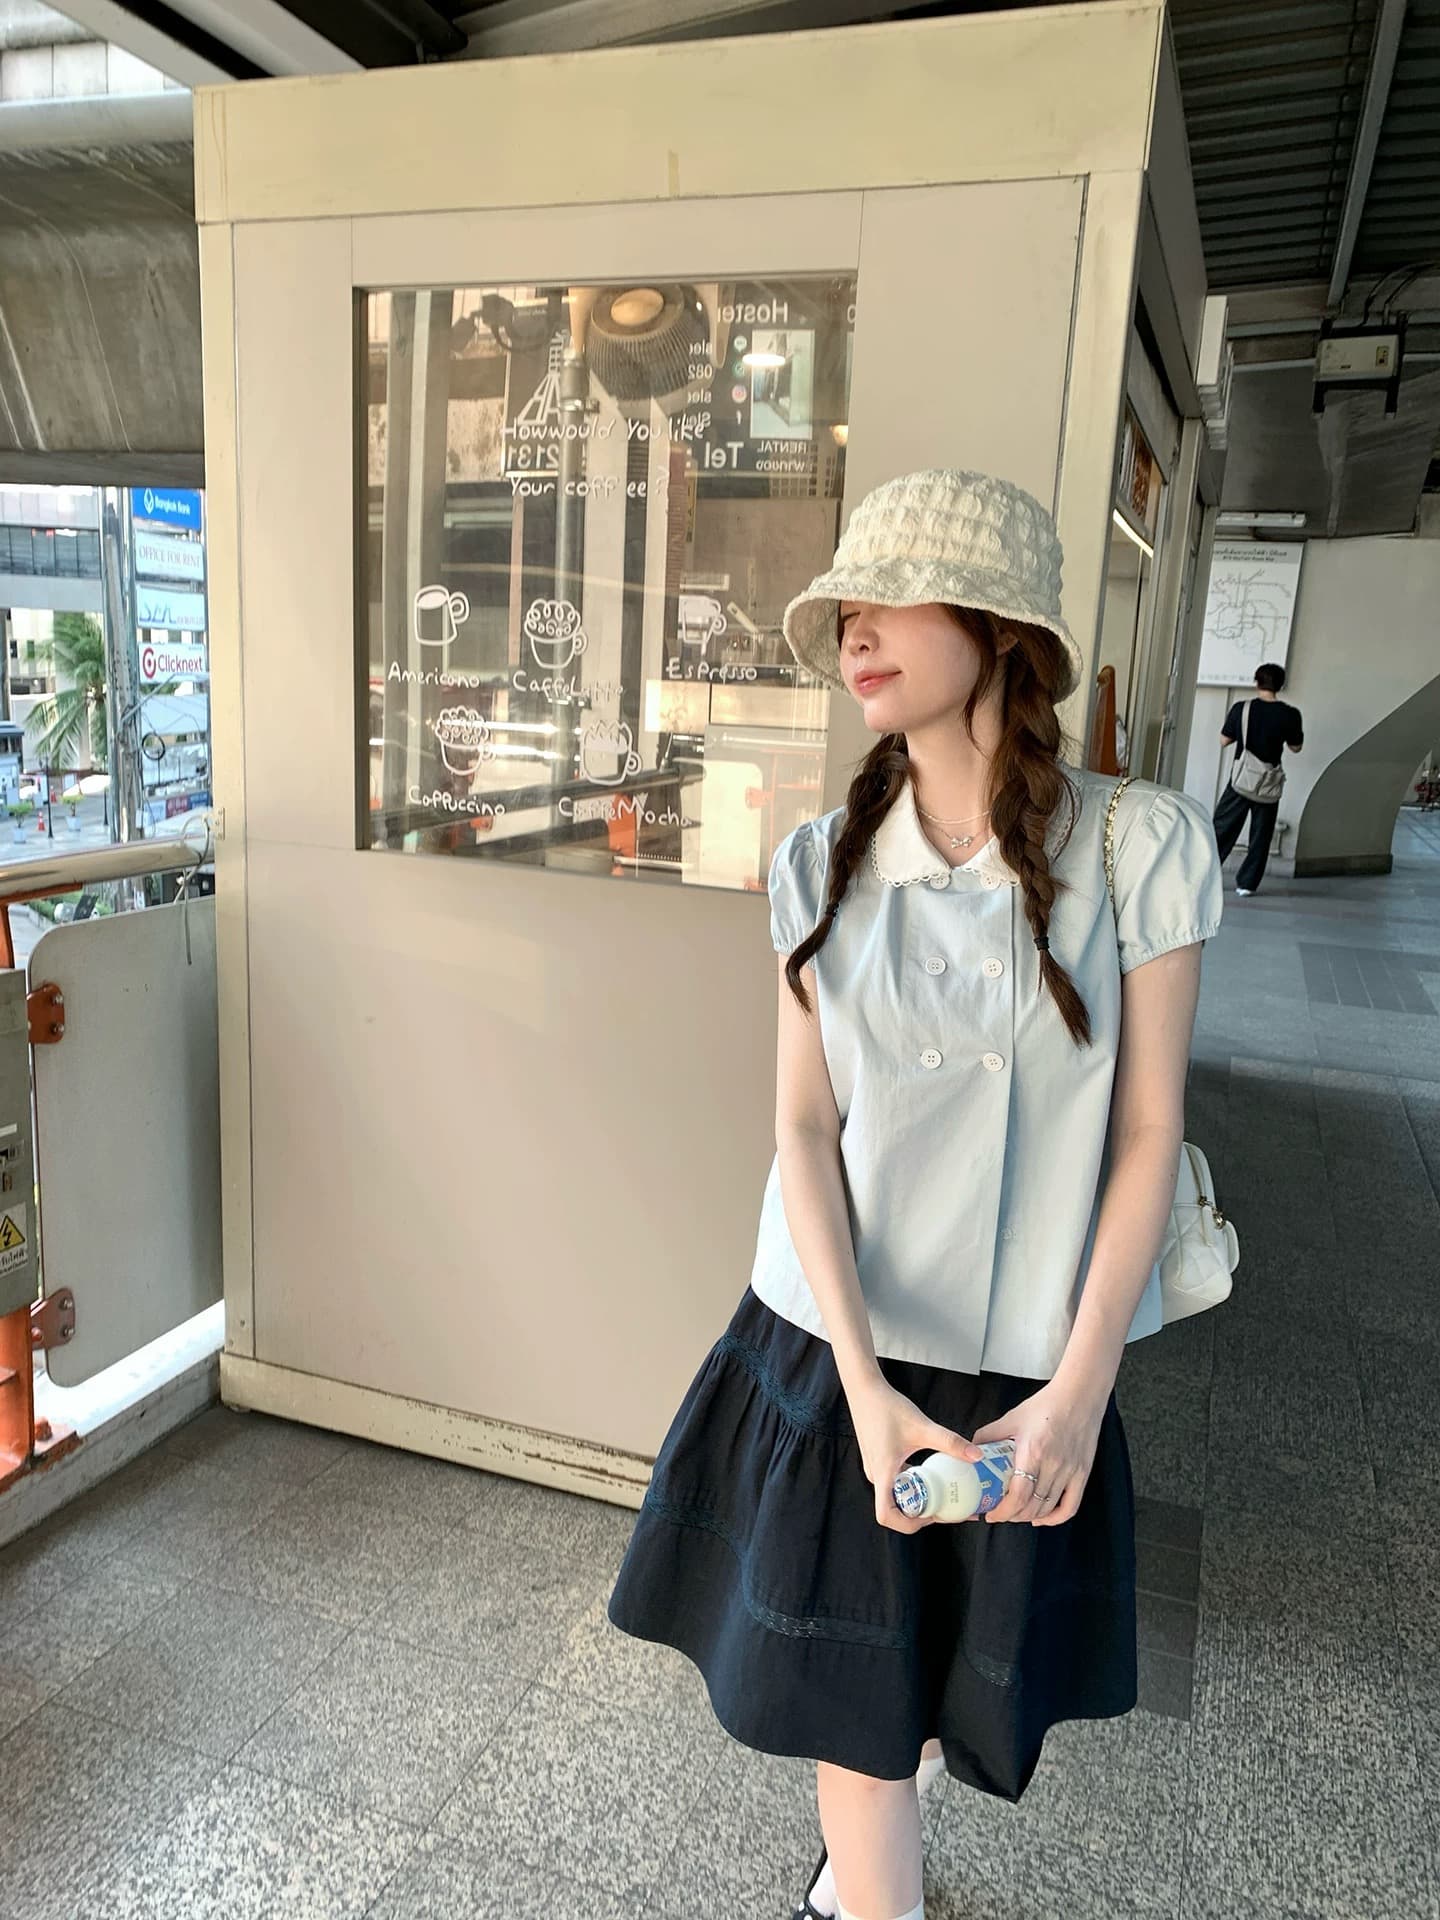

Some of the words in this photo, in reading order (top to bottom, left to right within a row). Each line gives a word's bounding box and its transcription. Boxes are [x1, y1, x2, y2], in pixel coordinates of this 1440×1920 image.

[510, 476, 556, 496] Your
[138, 545, 165, 562] OFFICE
[167, 550, 181, 564] FOR
[182, 553, 200, 568] RENT
[157, 654, 203, 673] Clicknext
[387, 660, 480, 689] Americano
